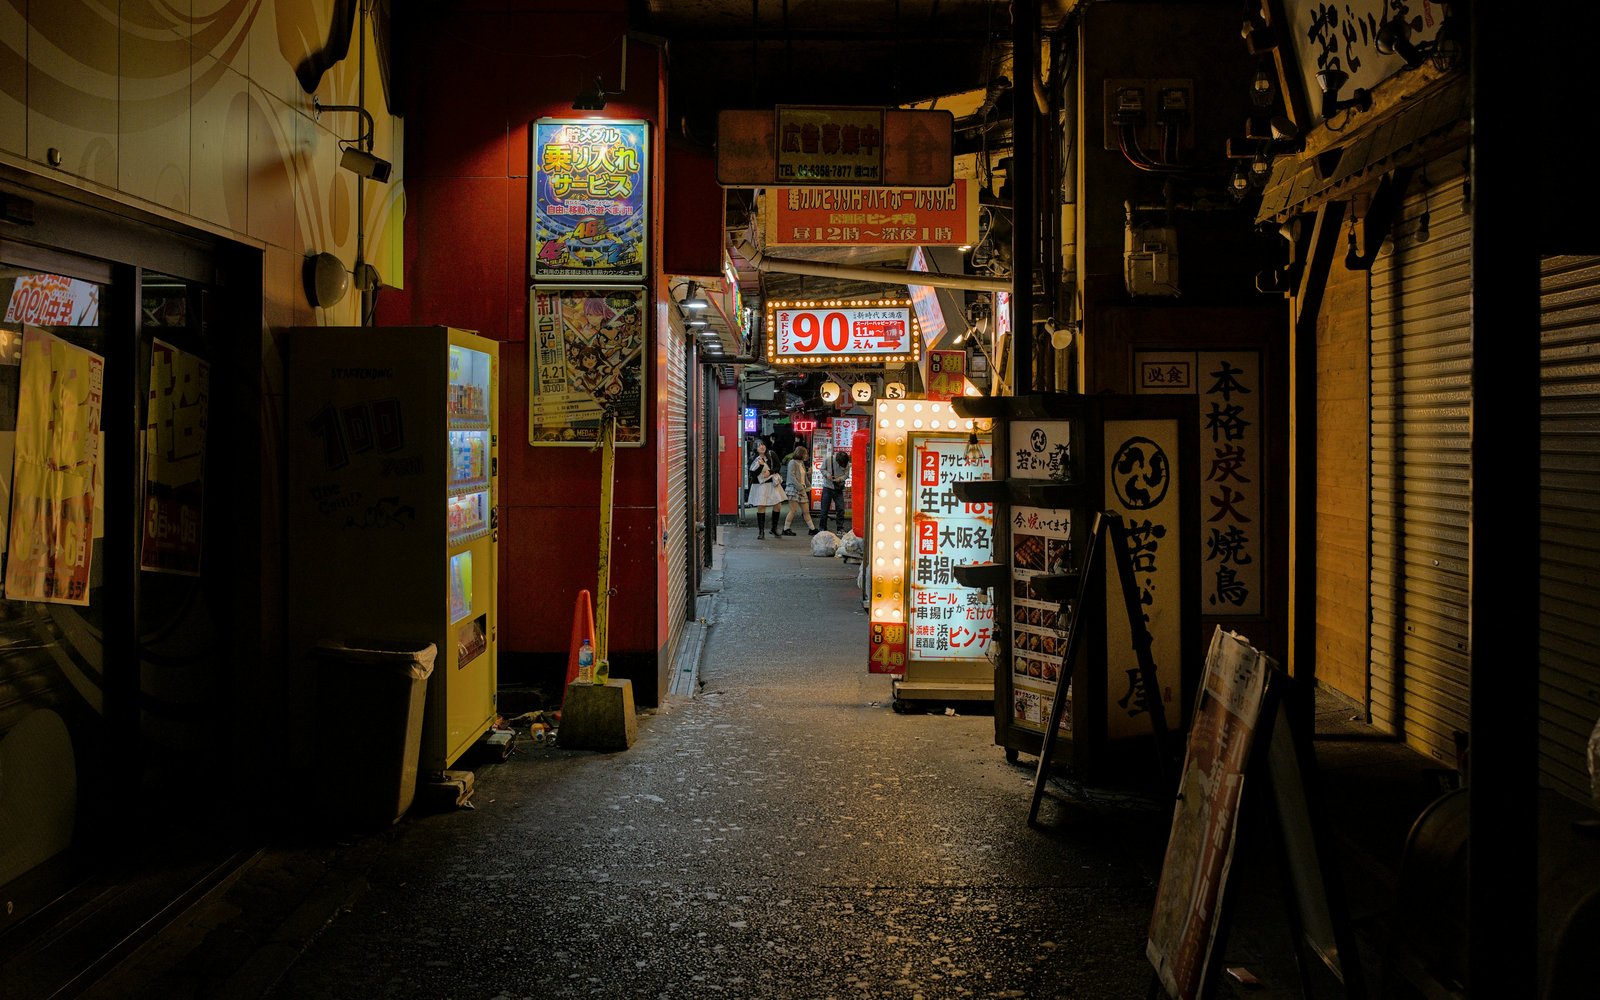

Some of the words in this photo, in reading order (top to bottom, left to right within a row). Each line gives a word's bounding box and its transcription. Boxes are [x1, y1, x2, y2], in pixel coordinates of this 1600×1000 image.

[783, 122, 879, 155] 広告募集中
[543, 144, 639, 172] 乗り入れ
[780, 164, 795, 176] TEL
[551, 173, 633, 198] サービス
[779, 312, 790, 353] 全ドリンク
[792, 311, 850, 352] 90
[853, 339, 878, 350] えん
[541, 366, 565, 380] 4.21
[1148, 366, 1184, 383] 必食
[1204, 360, 1252, 606] 本格炭火焼鳥
[920, 487, 960, 514] 生中
[939, 525, 993, 549] 大阪名
[916, 591, 958, 605] 生ビール
[916, 606, 955, 620] 串揚げ
[949, 625, 991, 649] ピンチ
